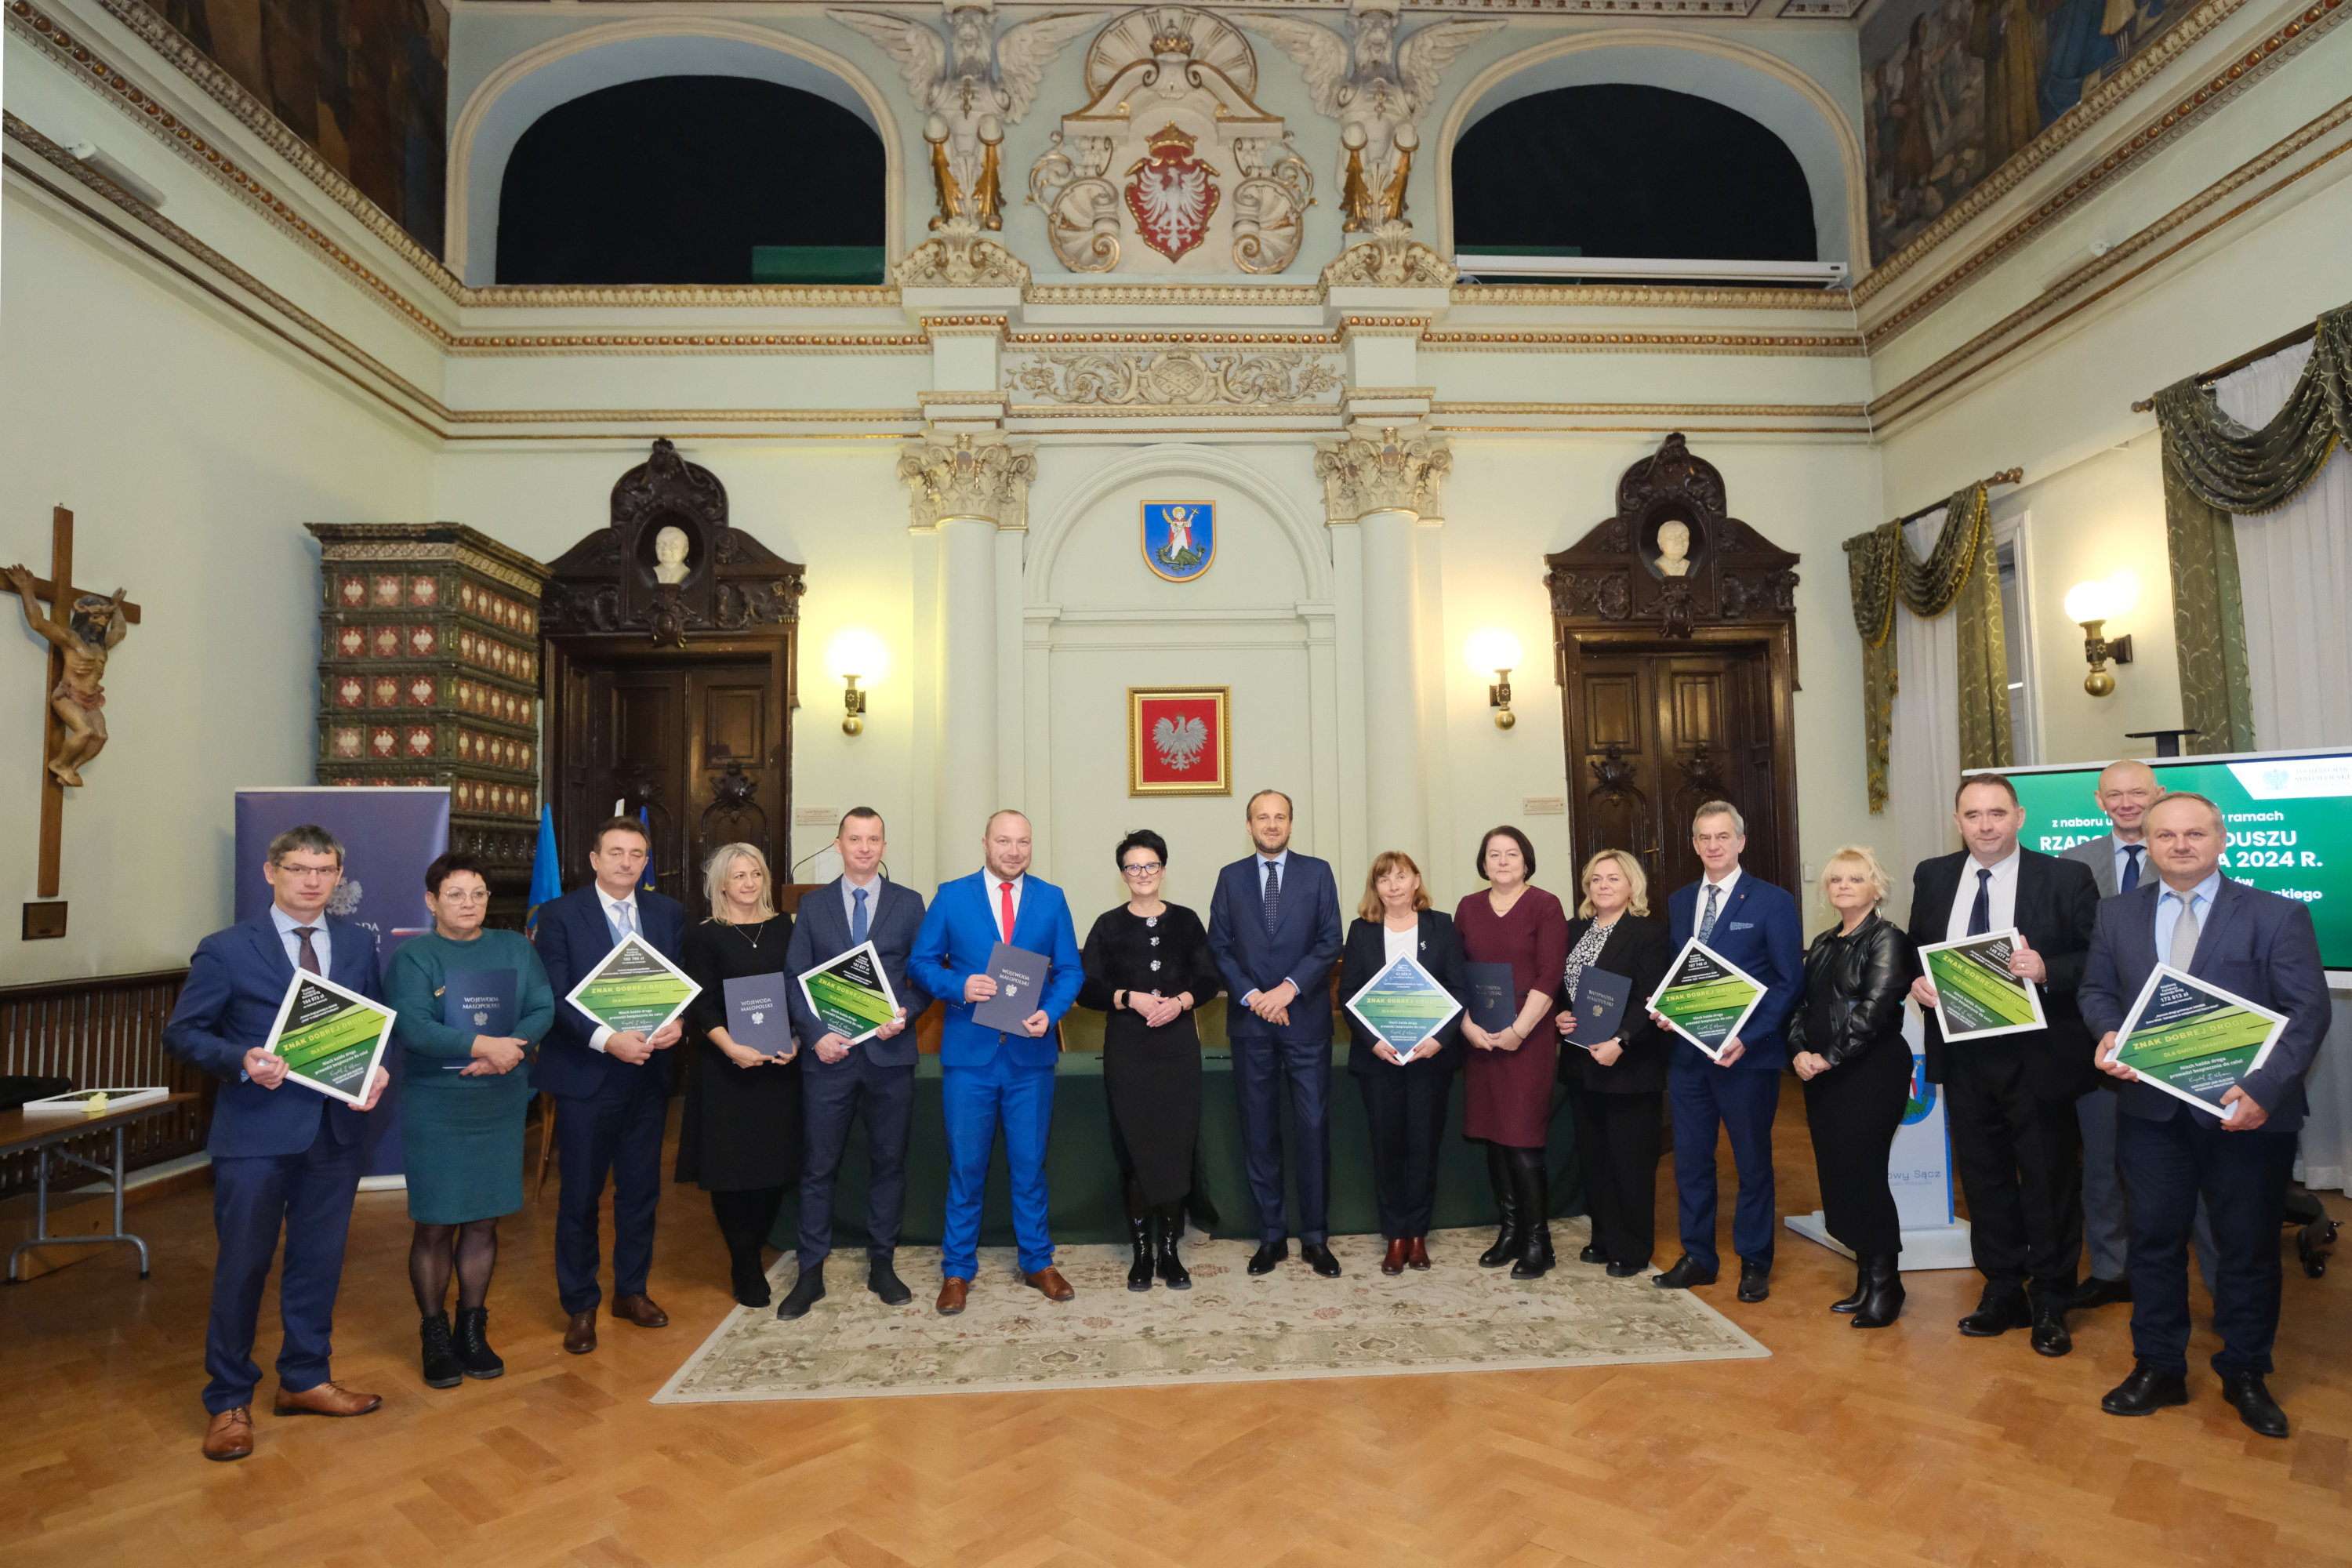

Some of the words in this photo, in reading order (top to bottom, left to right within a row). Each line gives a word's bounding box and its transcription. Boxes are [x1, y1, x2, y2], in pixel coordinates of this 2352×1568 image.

[2060, 817, 2103, 827] naboru
[2228, 811, 2285, 822] ramach
[2225, 830, 2297, 847] DUSZU
[2218, 852, 2231, 867] A
[2236, 851, 2295, 867] 2024
[2300, 851, 2323, 867] R.
[999, 974, 1029, 986] MAŁOPOLSKI
[1002, 968, 1029, 981] WOJEWODA
[1943, 955, 1963, 971] ZNAK
[1965, 969, 1994, 989] DOBREJ
[1996, 988, 2020, 1005] DROGI
[818, 978, 835, 989] ZNAK
[837, 986, 861, 999] DOBREJ
[1687, 989, 1714, 998] DOBREJ
[741, 1004, 773, 1012] MAŁOPOLSKI
[283, 1038, 307, 1051] ZNAK
[308, 1025, 340, 1041] DOBREJ
[2132, 1038, 2162, 1050] ZNAK
[2165, 1028, 2207, 1043] DOBREJ
[2210, 1019, 2244, 1032] DROGI
[2169, 1070, 2192, 1079] prowadzi
[2193, 1064, 2222, 1073] bezpiecznie
[1887, 1172, 1909, 1181] owy
[1914, 1170, 1941, 1180] Sącz
